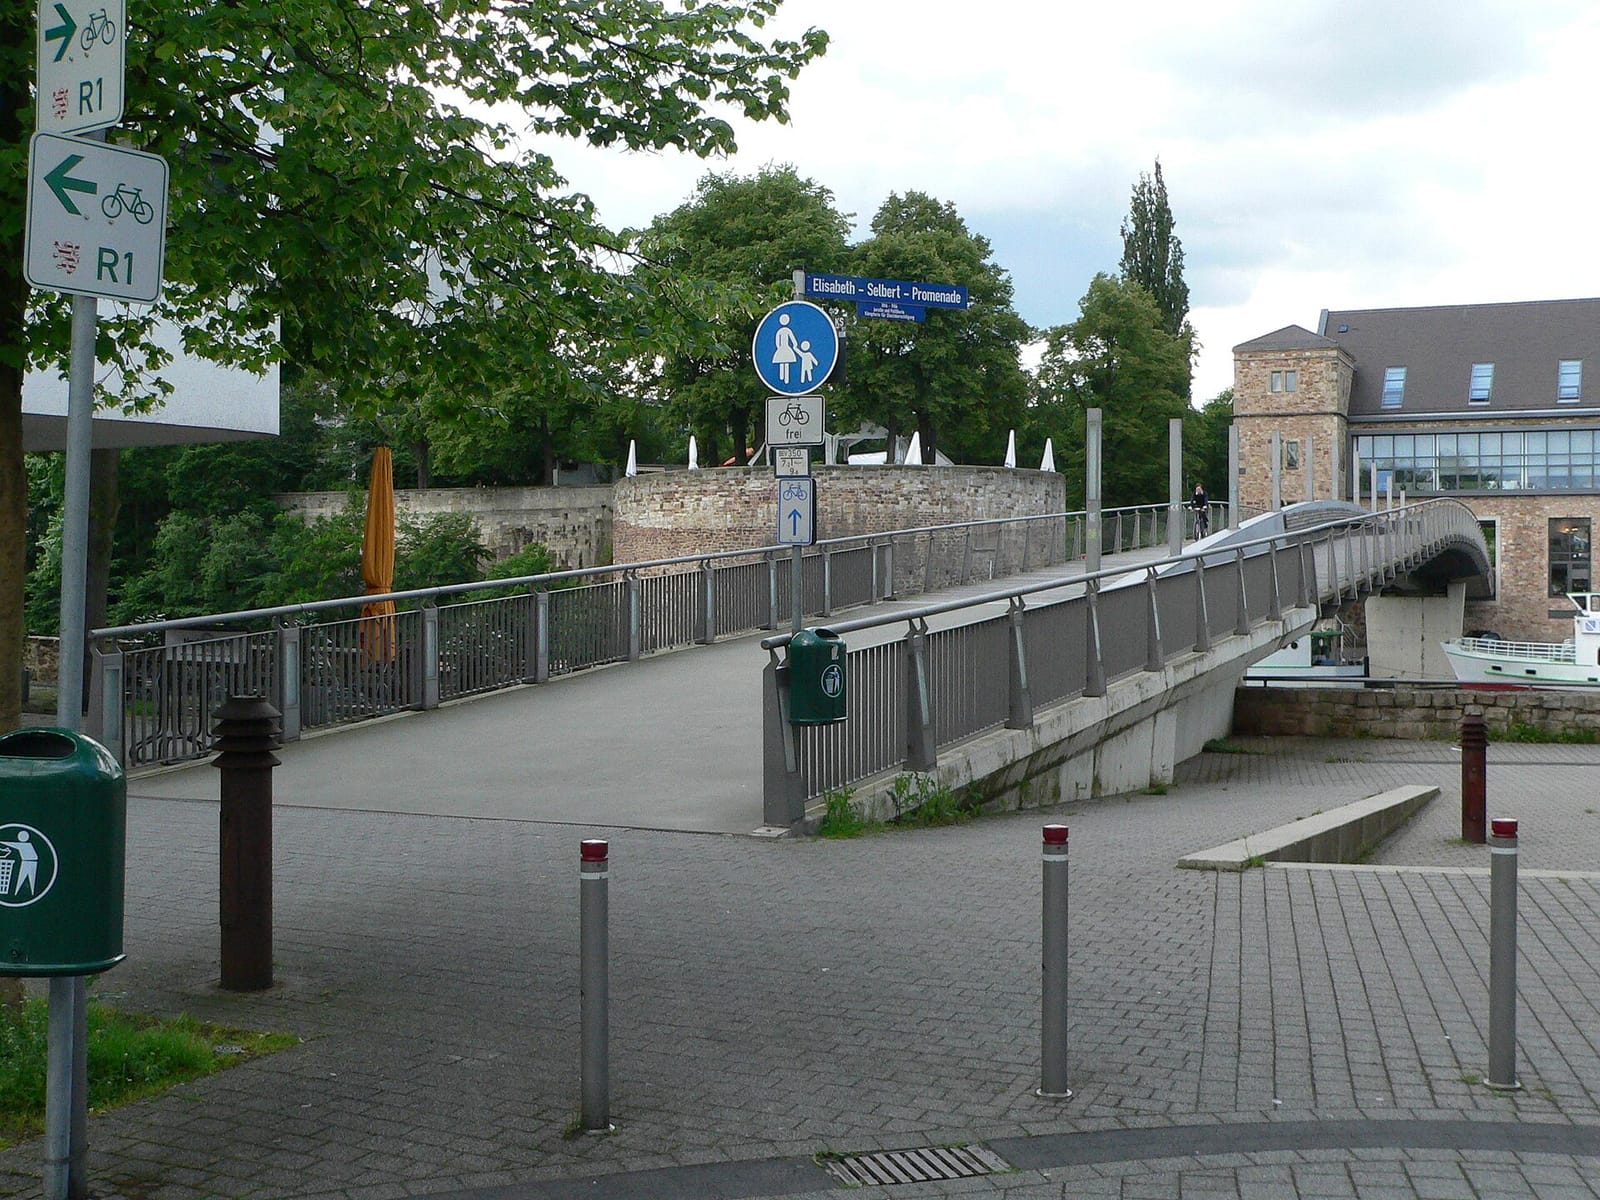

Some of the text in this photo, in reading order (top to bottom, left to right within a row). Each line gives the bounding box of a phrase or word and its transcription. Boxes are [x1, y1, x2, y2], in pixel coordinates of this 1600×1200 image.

[79, 77, 104, 115] R1
[97, 247, 134, 285] R1
[813, 278, 856, 295] Elisabeth
[867, 282, 901, 299] Selbert
[912, 286, 961, 304] Promenade
[786, 428, 802, 440] frei
